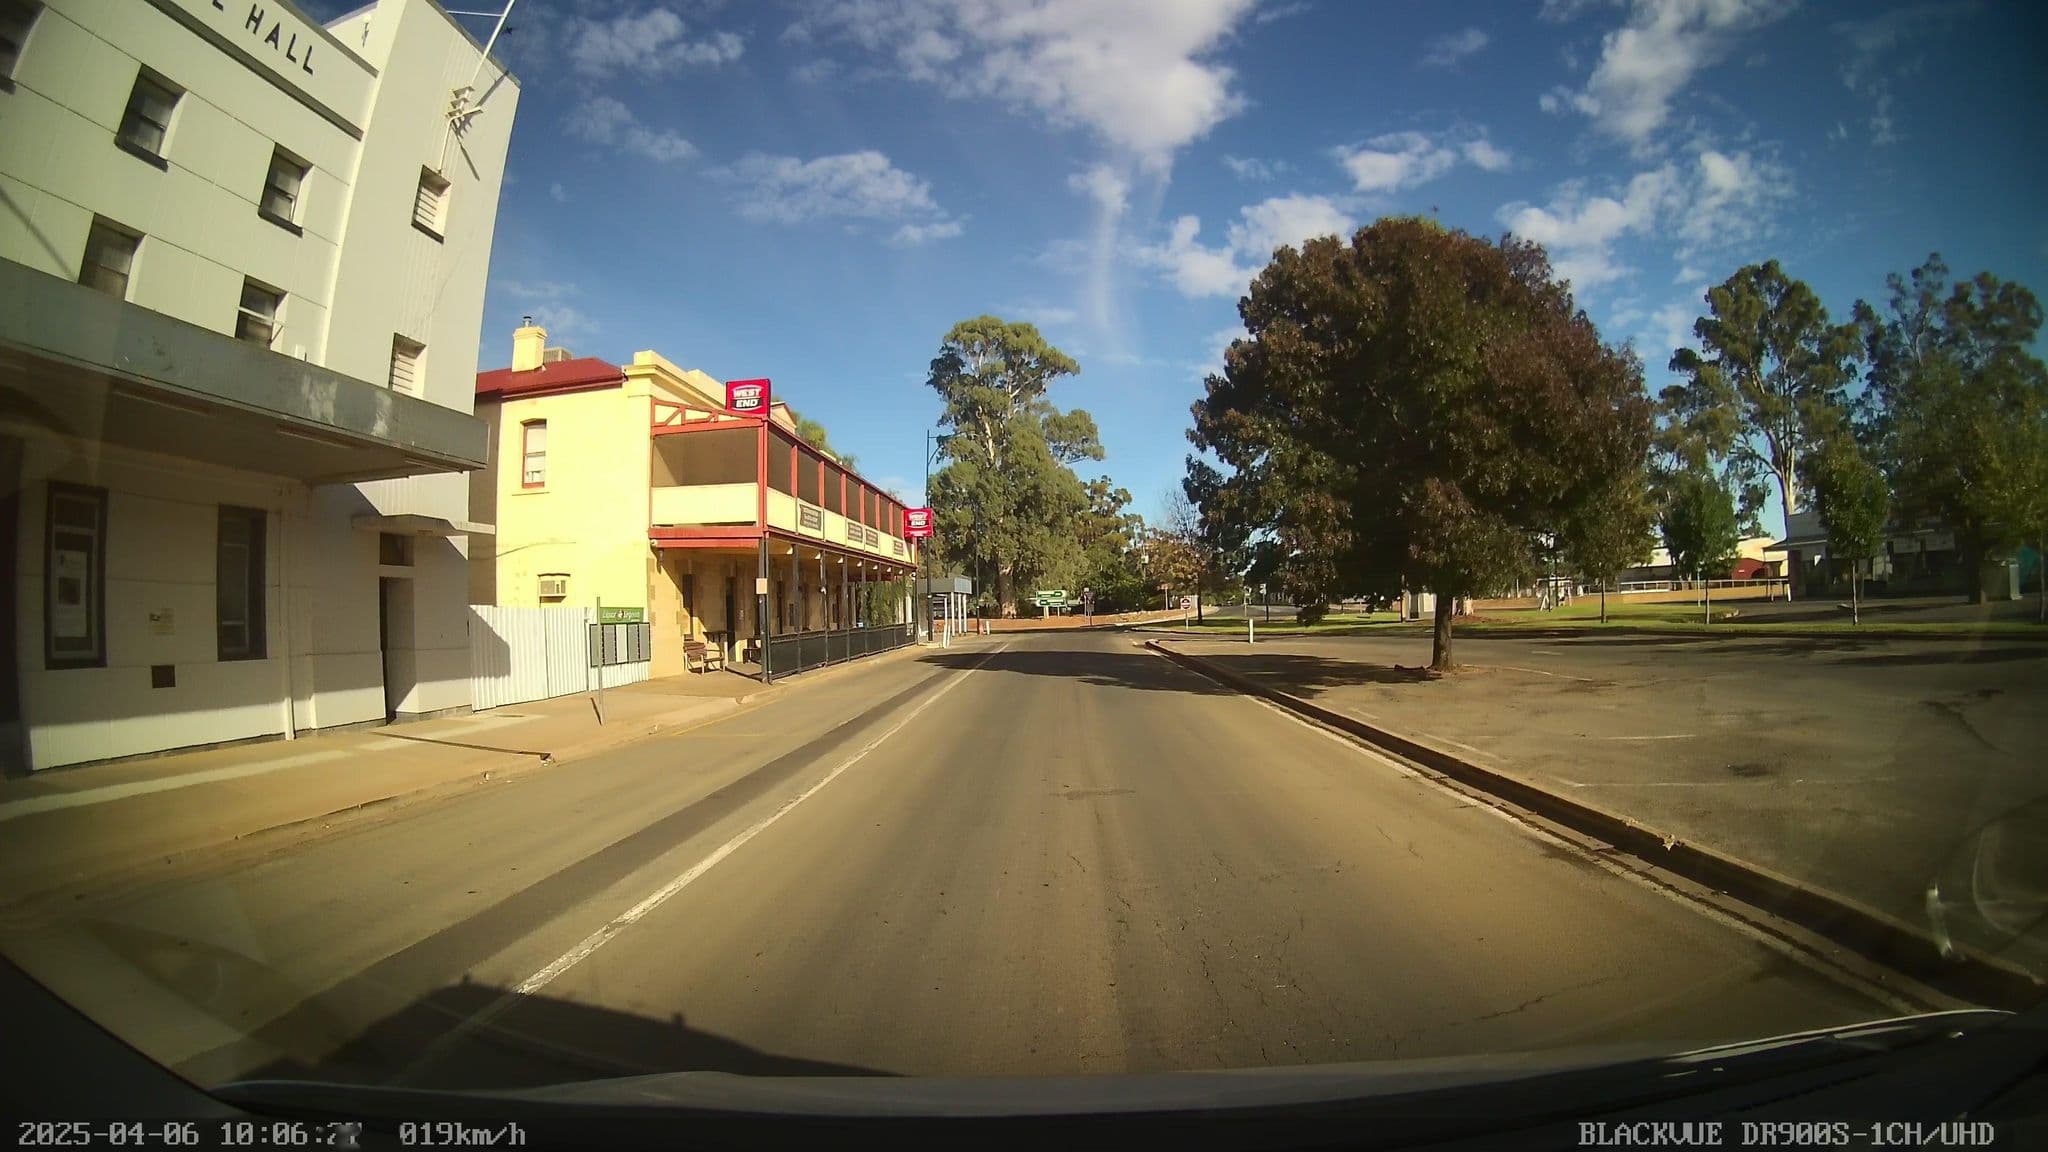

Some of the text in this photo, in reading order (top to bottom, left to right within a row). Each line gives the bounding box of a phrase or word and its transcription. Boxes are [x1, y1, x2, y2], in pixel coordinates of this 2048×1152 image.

[245, 3, 313, 75] HALL
[733, 387, 762, 398] WEST
[736, 399, 759, 408] END
